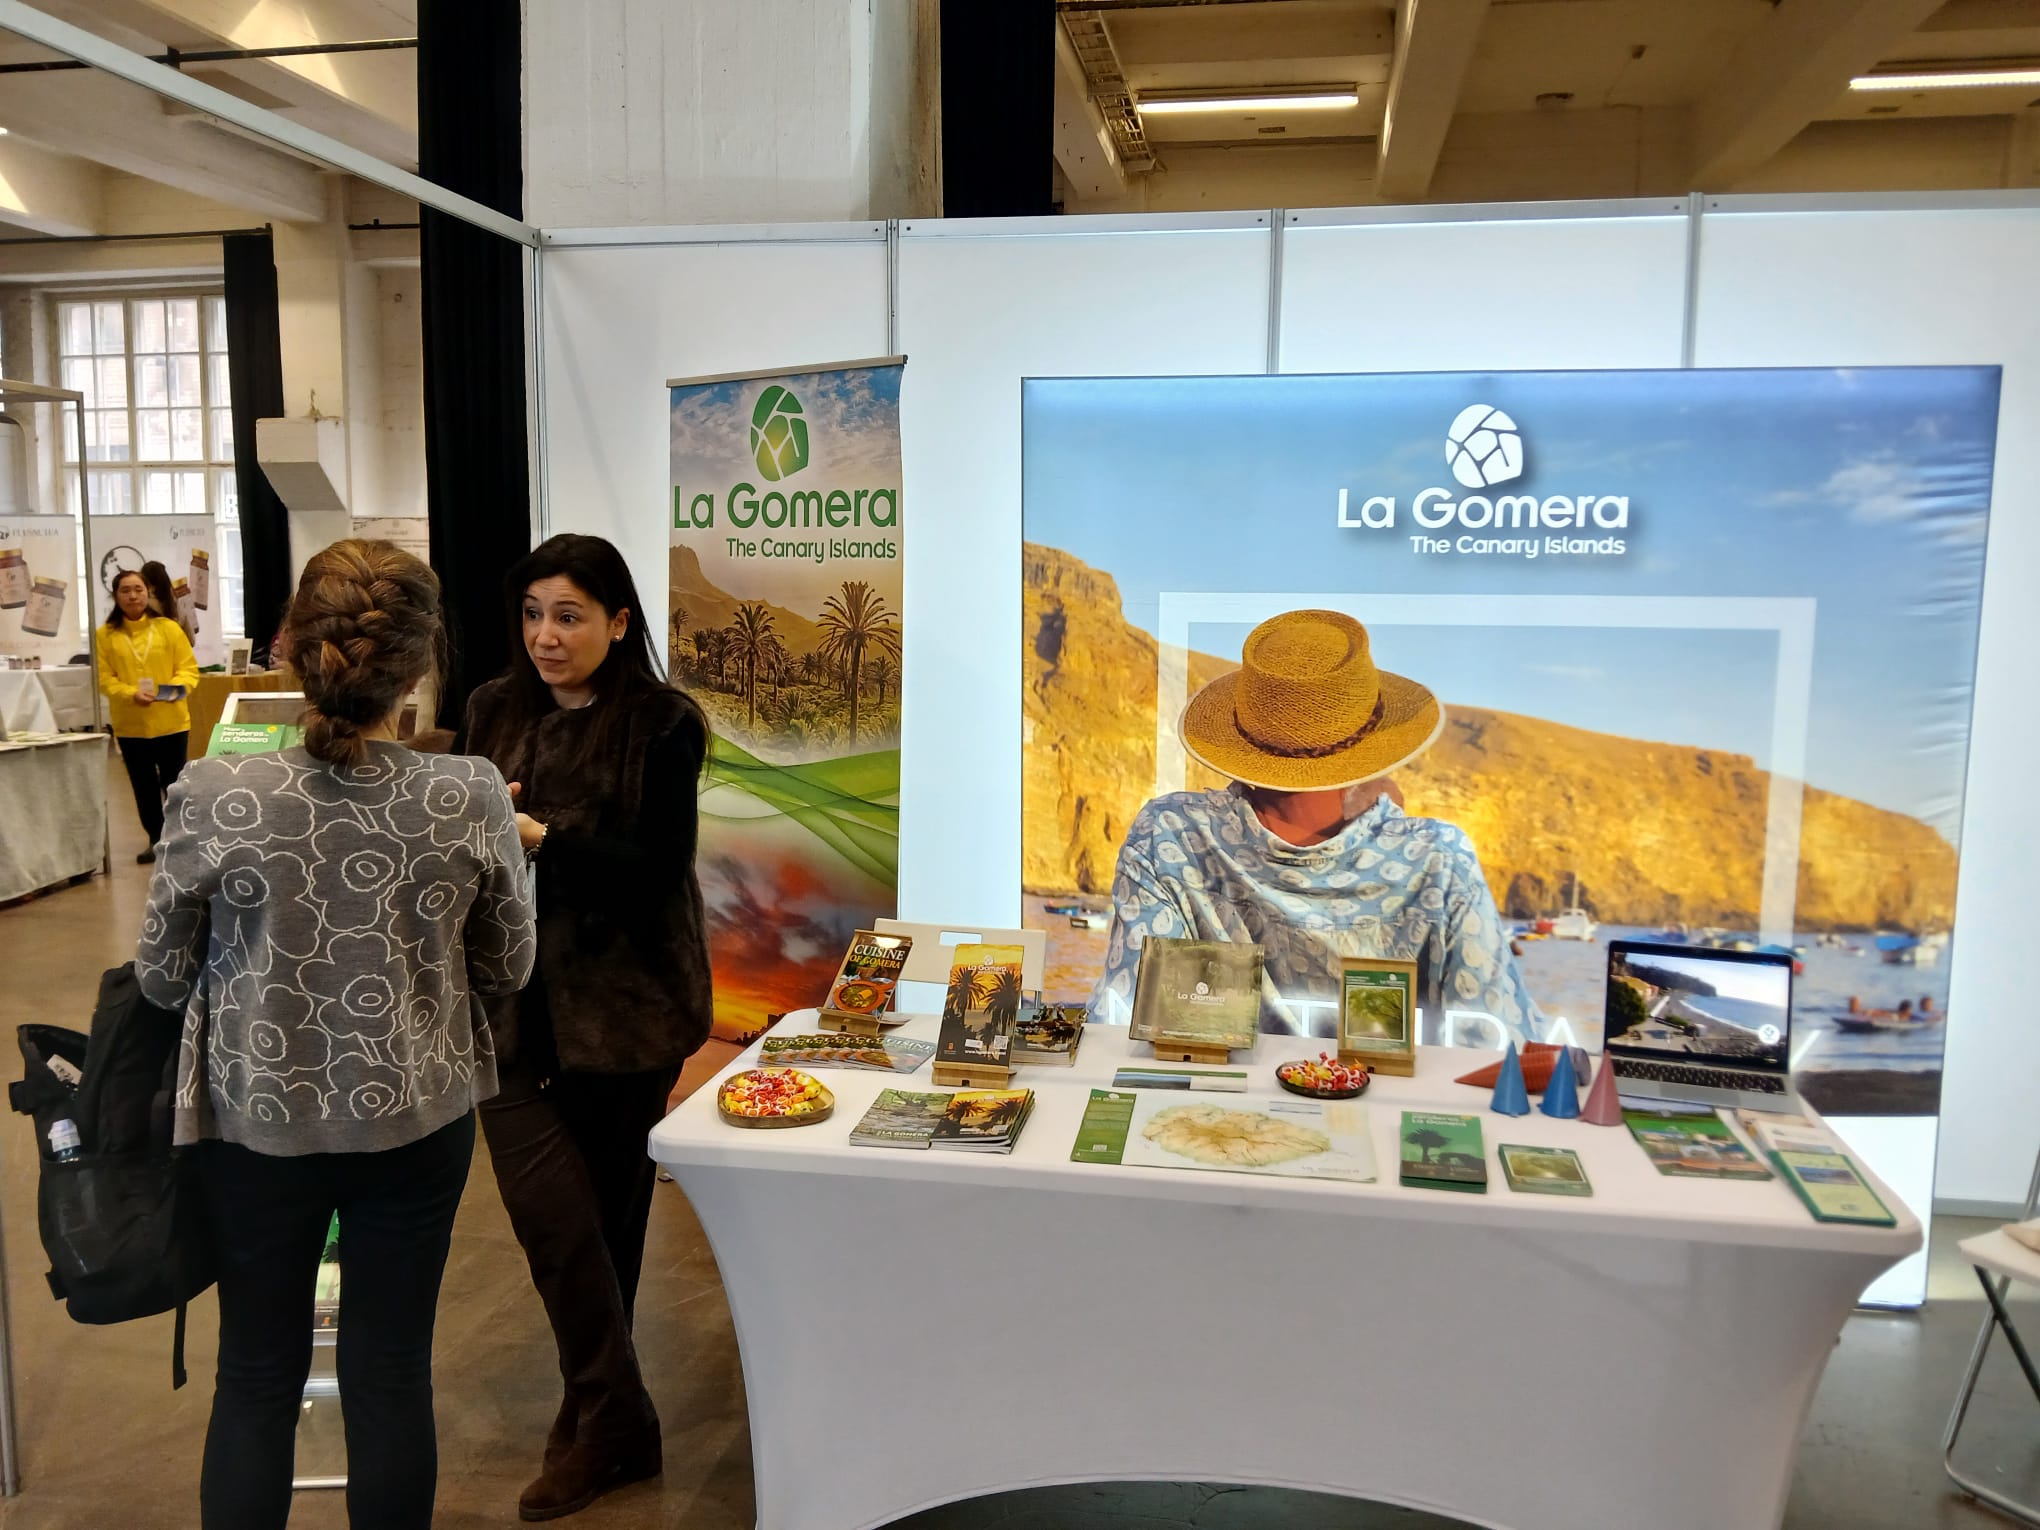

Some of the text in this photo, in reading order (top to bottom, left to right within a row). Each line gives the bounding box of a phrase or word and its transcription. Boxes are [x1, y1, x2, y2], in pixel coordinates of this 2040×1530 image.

[674, 482, 897, 529] La Gomera
[1337, 487, 1629, 529] La Gomera
[726, 537, 897, 564] The Canary Islands
[1410, 535, 1626, 559] The Canary Islands
[854, 944, 906, 961] CUISINE
[849, 954, 901, 969] OF GOMERA
[968, 963, 1007, 972] La Gomera
[1177, 992, 1225, 1002] La Gomera
[894, 1130, 930, 1138] GOMERA
